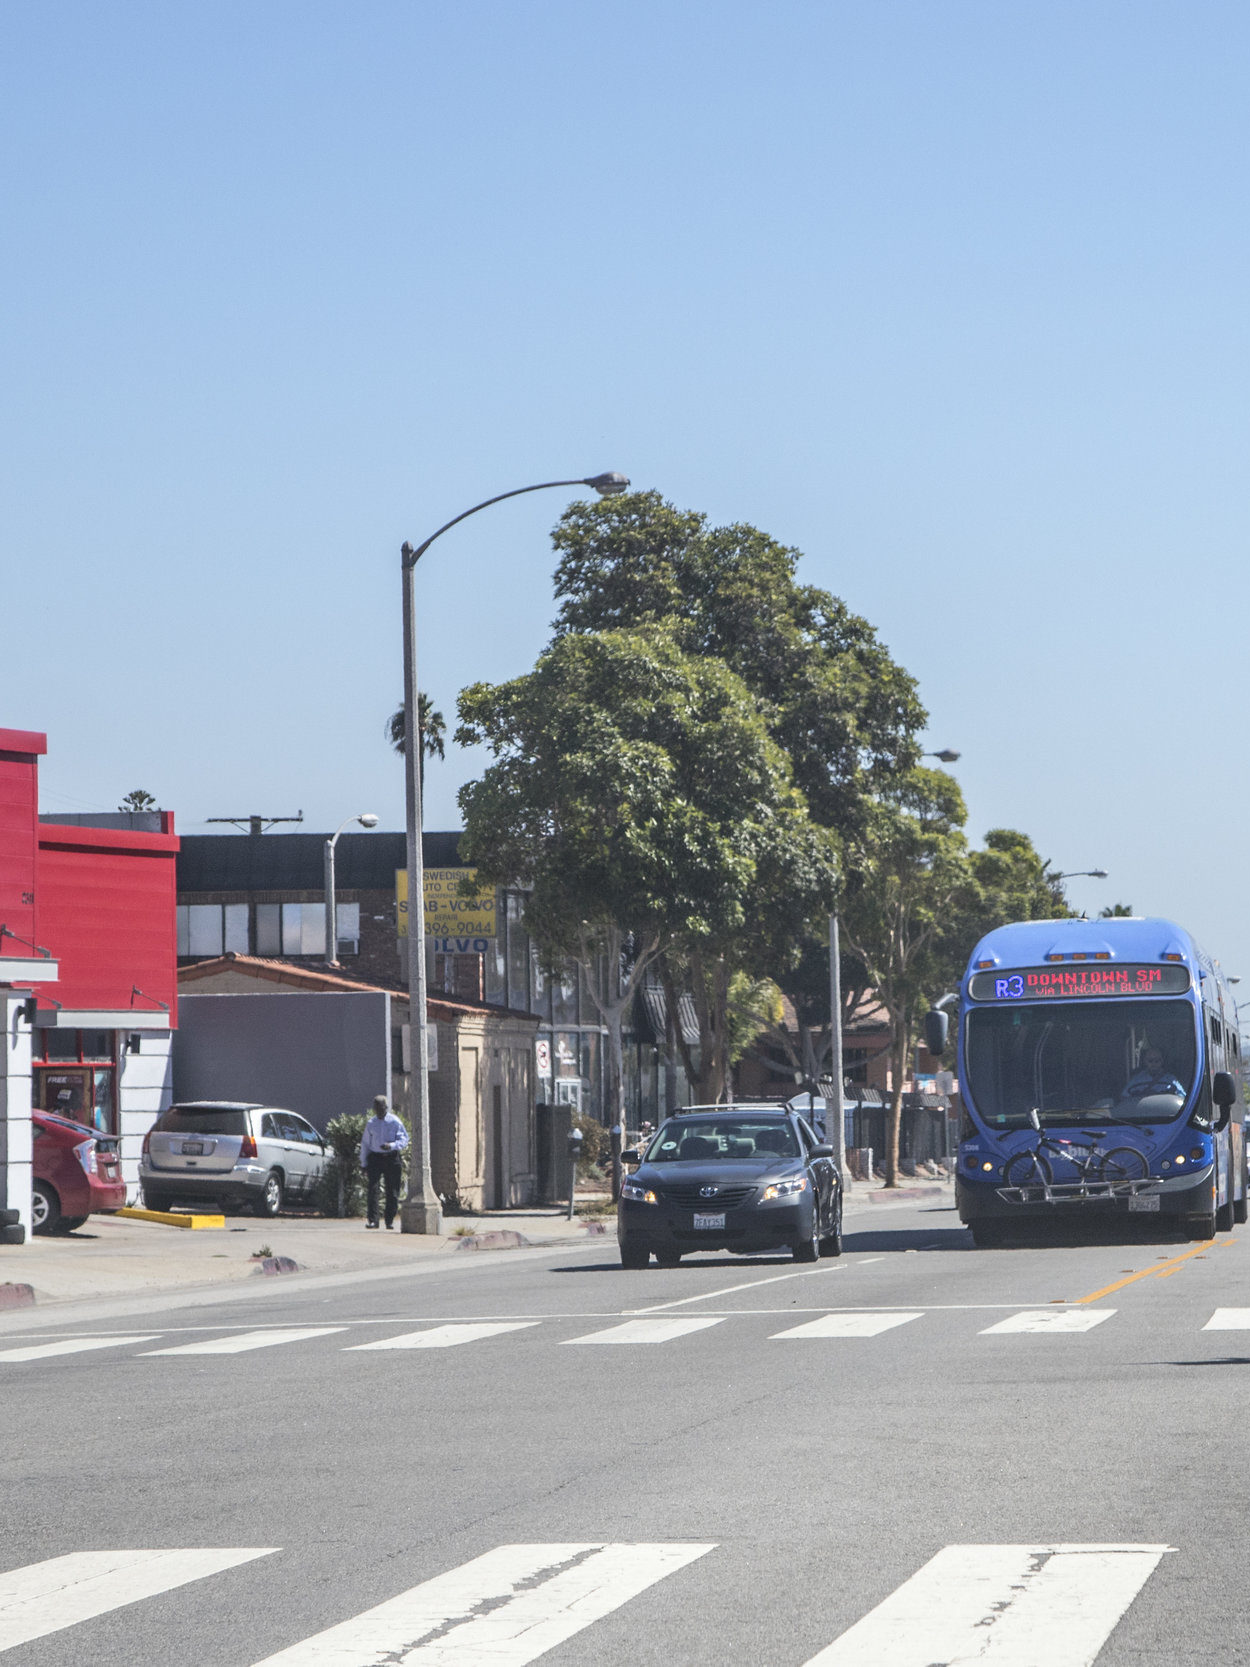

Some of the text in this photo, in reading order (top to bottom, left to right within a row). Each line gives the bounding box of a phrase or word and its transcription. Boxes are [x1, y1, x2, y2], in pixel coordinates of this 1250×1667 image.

[423, 871, 469, 881] SWEDISH
[423, 882, 442, 892] UTO
[434, 938, 489, 952] LVO
[1027, 969, 1162, 986] DOWNTOWN SM
[995, 975, 1024, 998] R3
[1060, 982, 1115, 995] LINCOLN
[1121, 981, 1153, 992] BLVD
